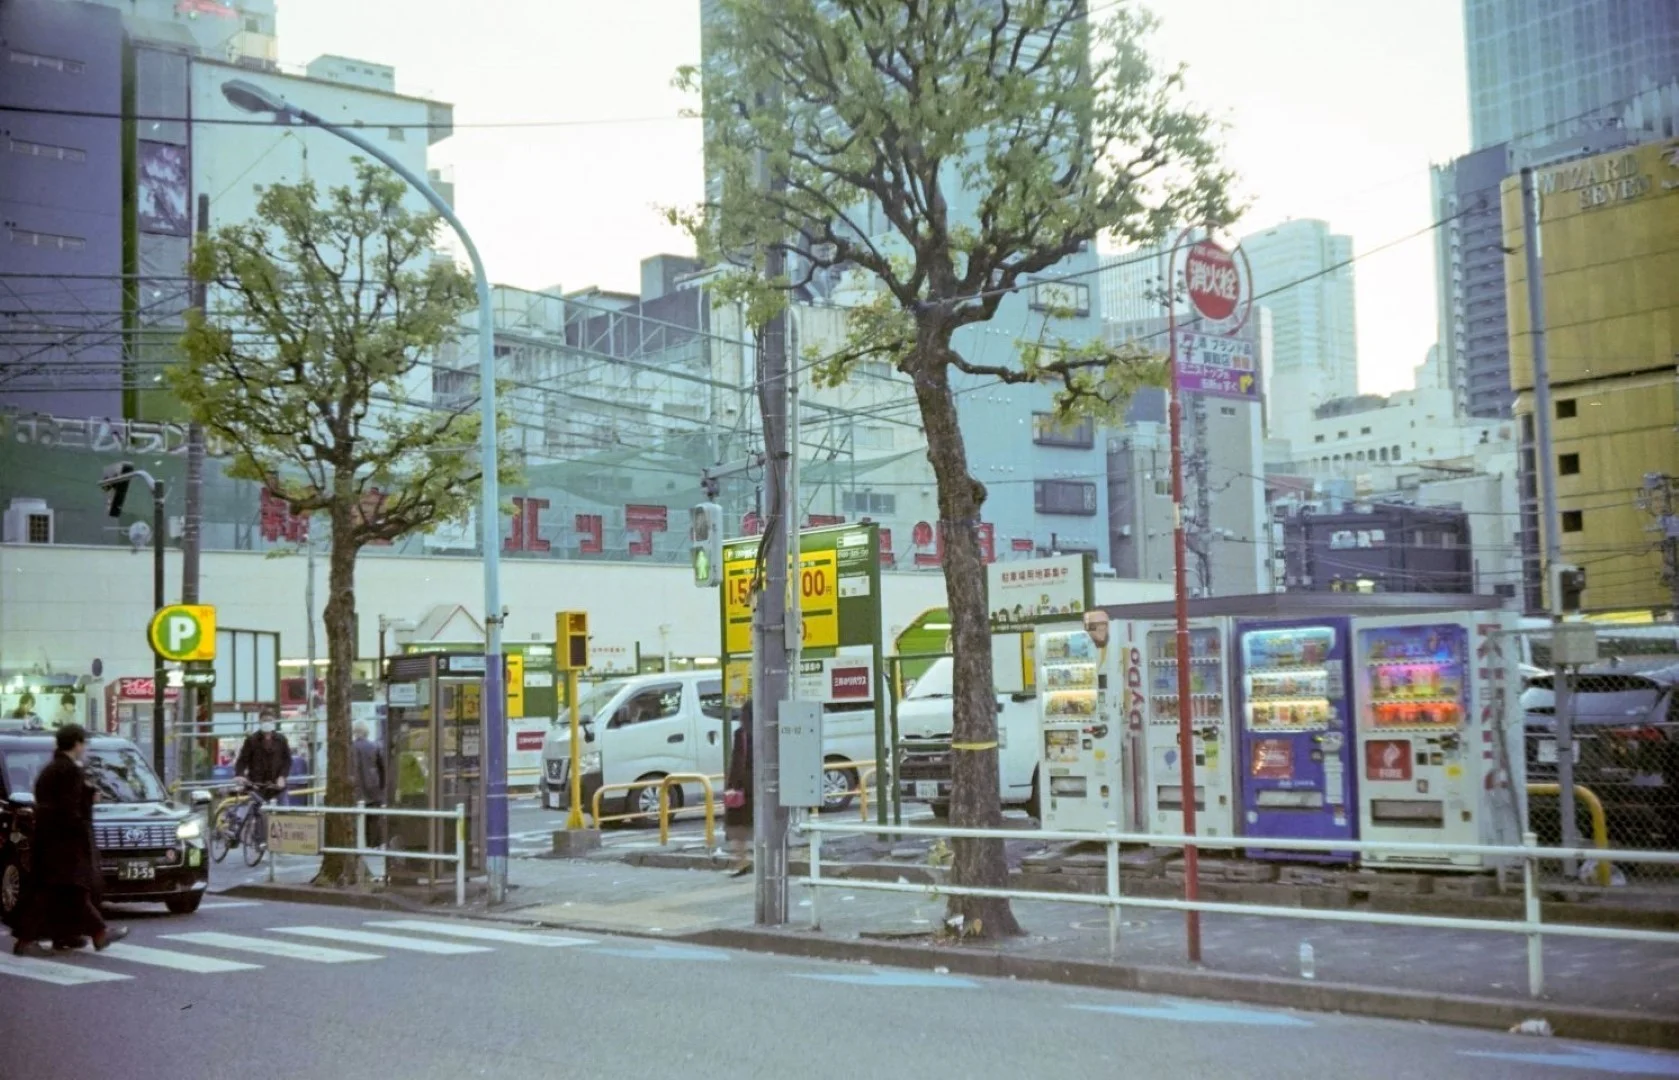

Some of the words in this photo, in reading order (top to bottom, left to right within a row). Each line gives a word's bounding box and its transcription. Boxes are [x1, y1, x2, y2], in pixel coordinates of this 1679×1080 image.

[1541, 154, 1638, 195] WIZARD
[1580, 175, 1650, 209] SEVEN
[1190, 259, 1237, 300] 消火栓
[169, 616, 197, 651] P
[1128, 647, 1146, 731] DyDo
